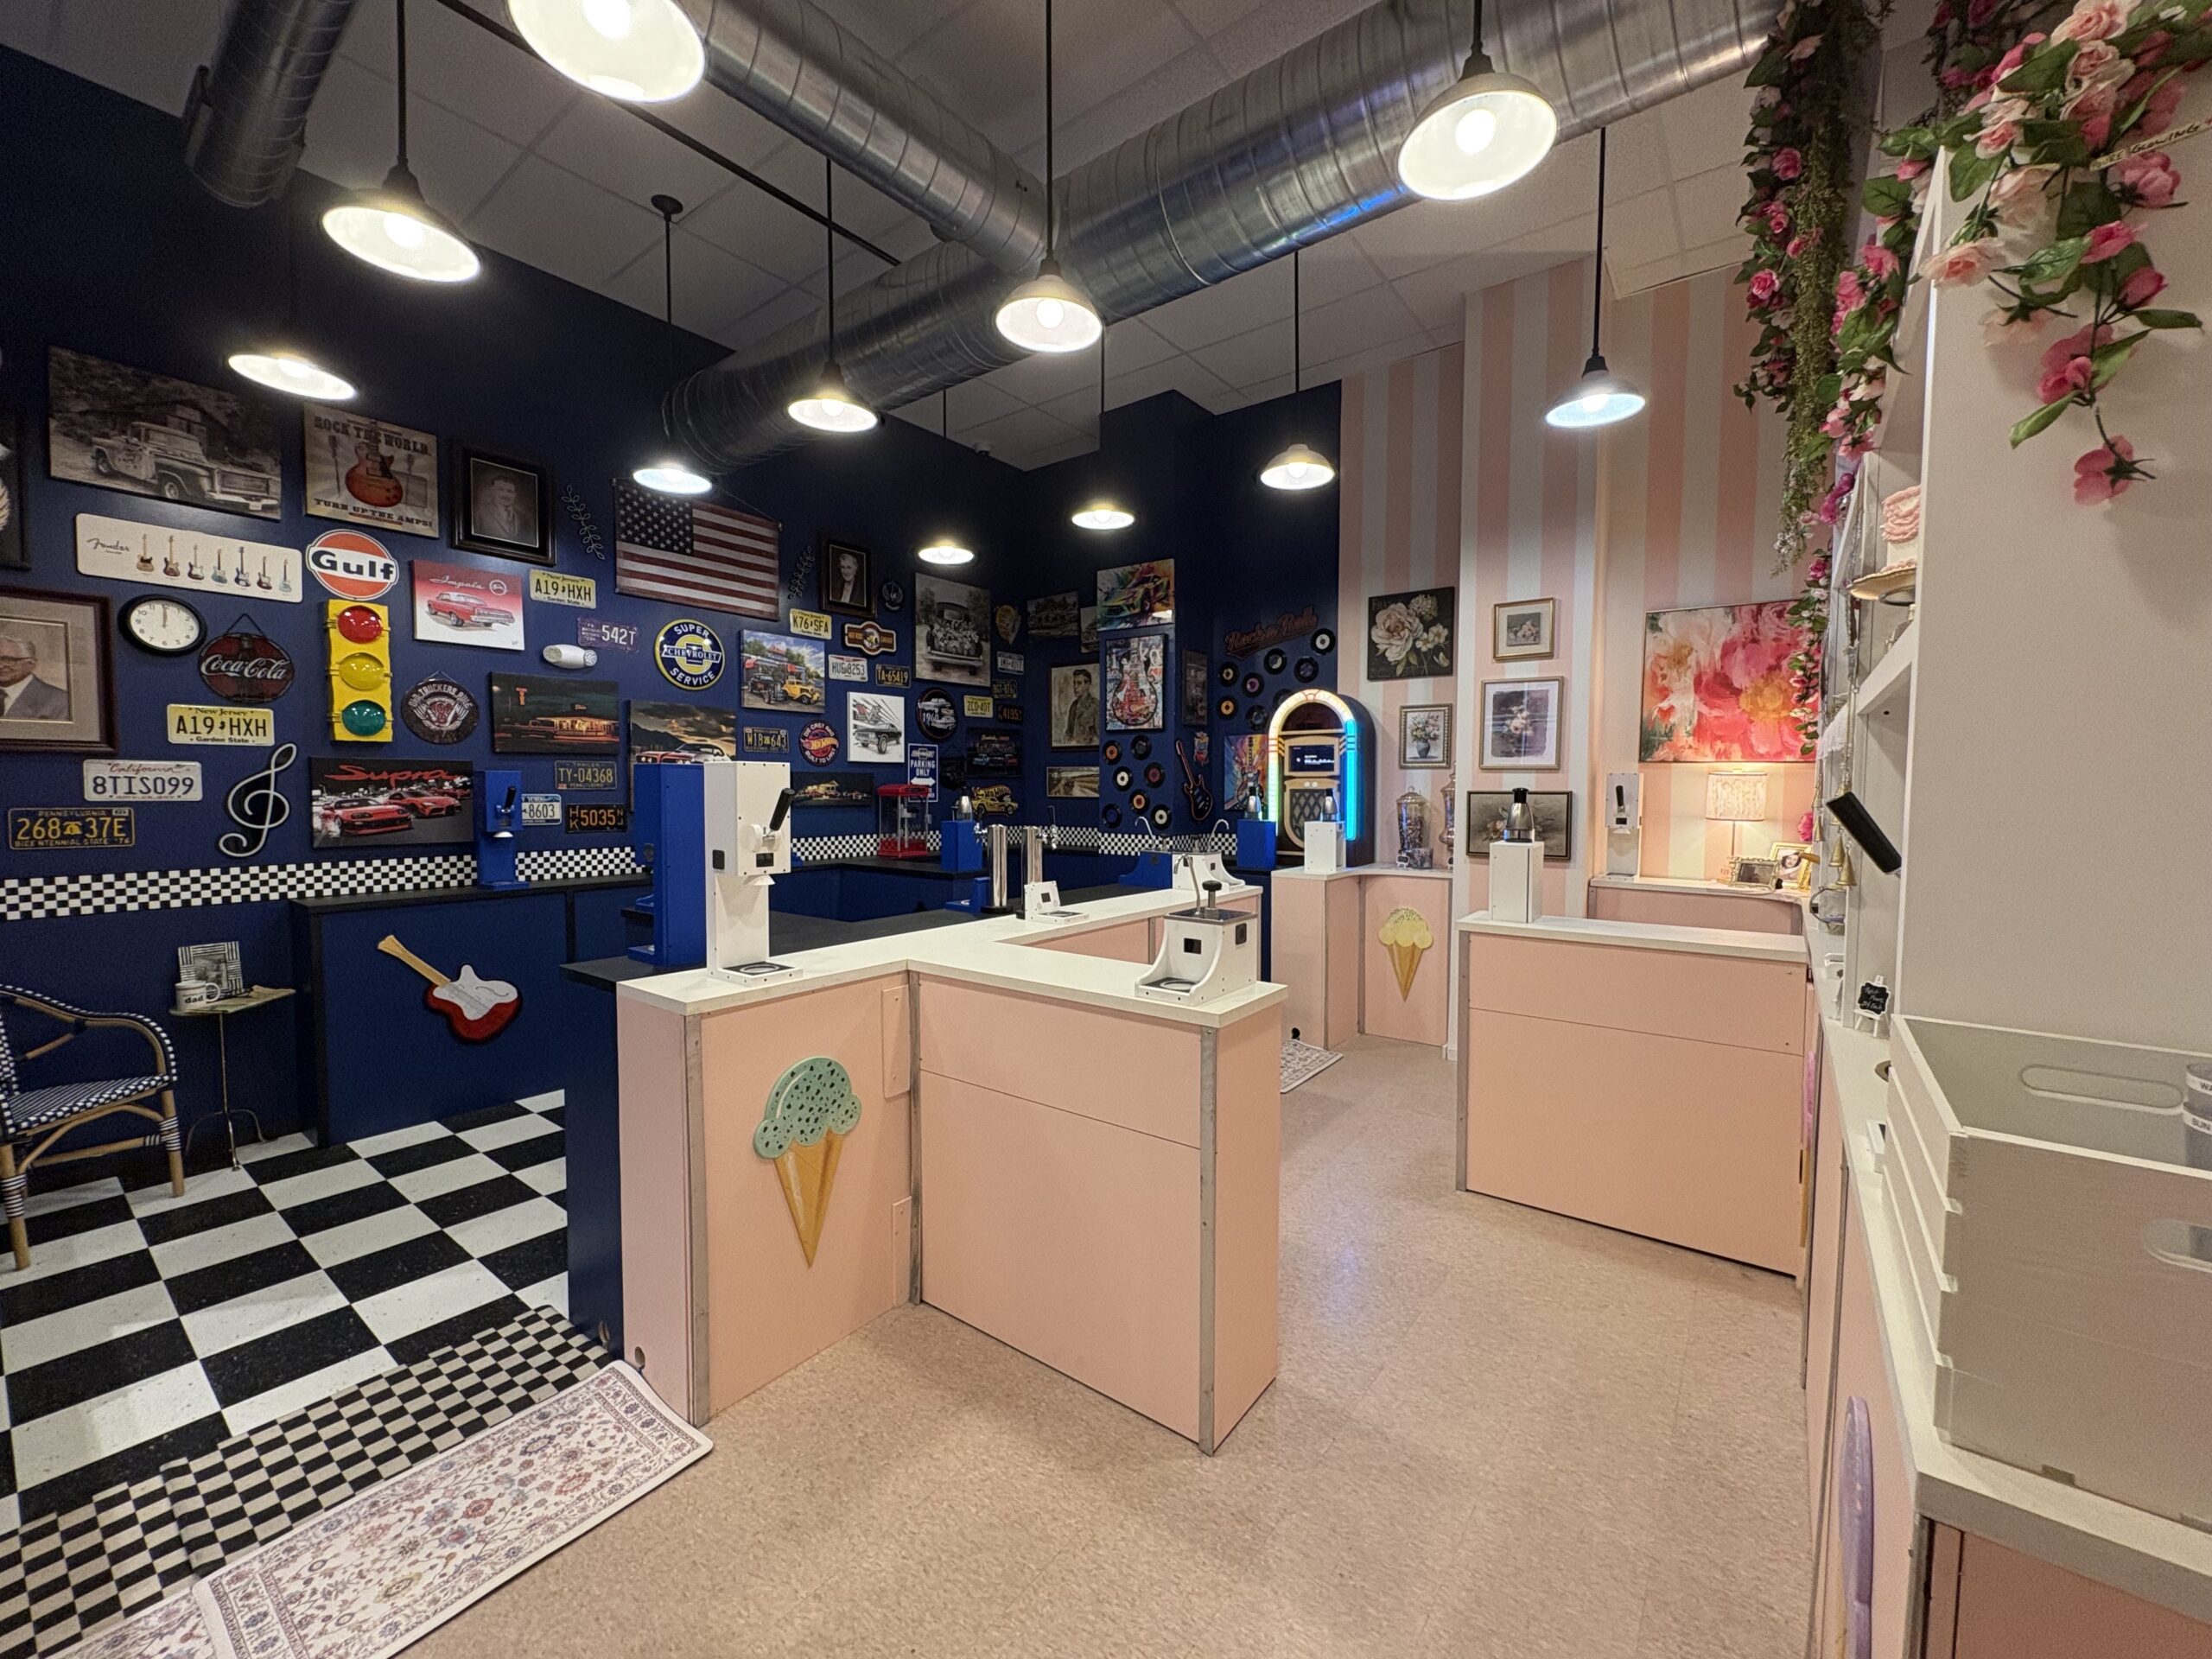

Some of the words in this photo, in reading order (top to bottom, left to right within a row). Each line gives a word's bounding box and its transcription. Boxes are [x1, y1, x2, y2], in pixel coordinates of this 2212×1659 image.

[314, 416, 350, 436] ROCK
[383, 433, 429, 454] WORLD
[314, 498, 348, 511] TURN
[86, 537, 130, 551] Fender
[312, 550, 394, 580] Gulf
[429, 575, 486, 590] Impala
[601, 624, 637, 645] 542T
[674, 623, 709, 639] SUPER
[667, 648, 717, 661] CHEVROLET
[670, 667, 715, 686] SERVICE
[417, 683, 458, 696] TRUCKERS
[175, 715, 214, 734] A19
[229, 717, 267, 737] HXH
[110, 763, 174, 775] California
[910, 759, 936, 769] PARKING
[916, 767, 930, 777] ONLY
[323, 764, 461, 790] Supra
[558, 767, 613, 783] TY-04368
[528, 804, 555, 818] 8603
[580, 810, 616, 826] 5035
[17, 817, 61, 840] 268
[85, 817, 126, 838] 37E
